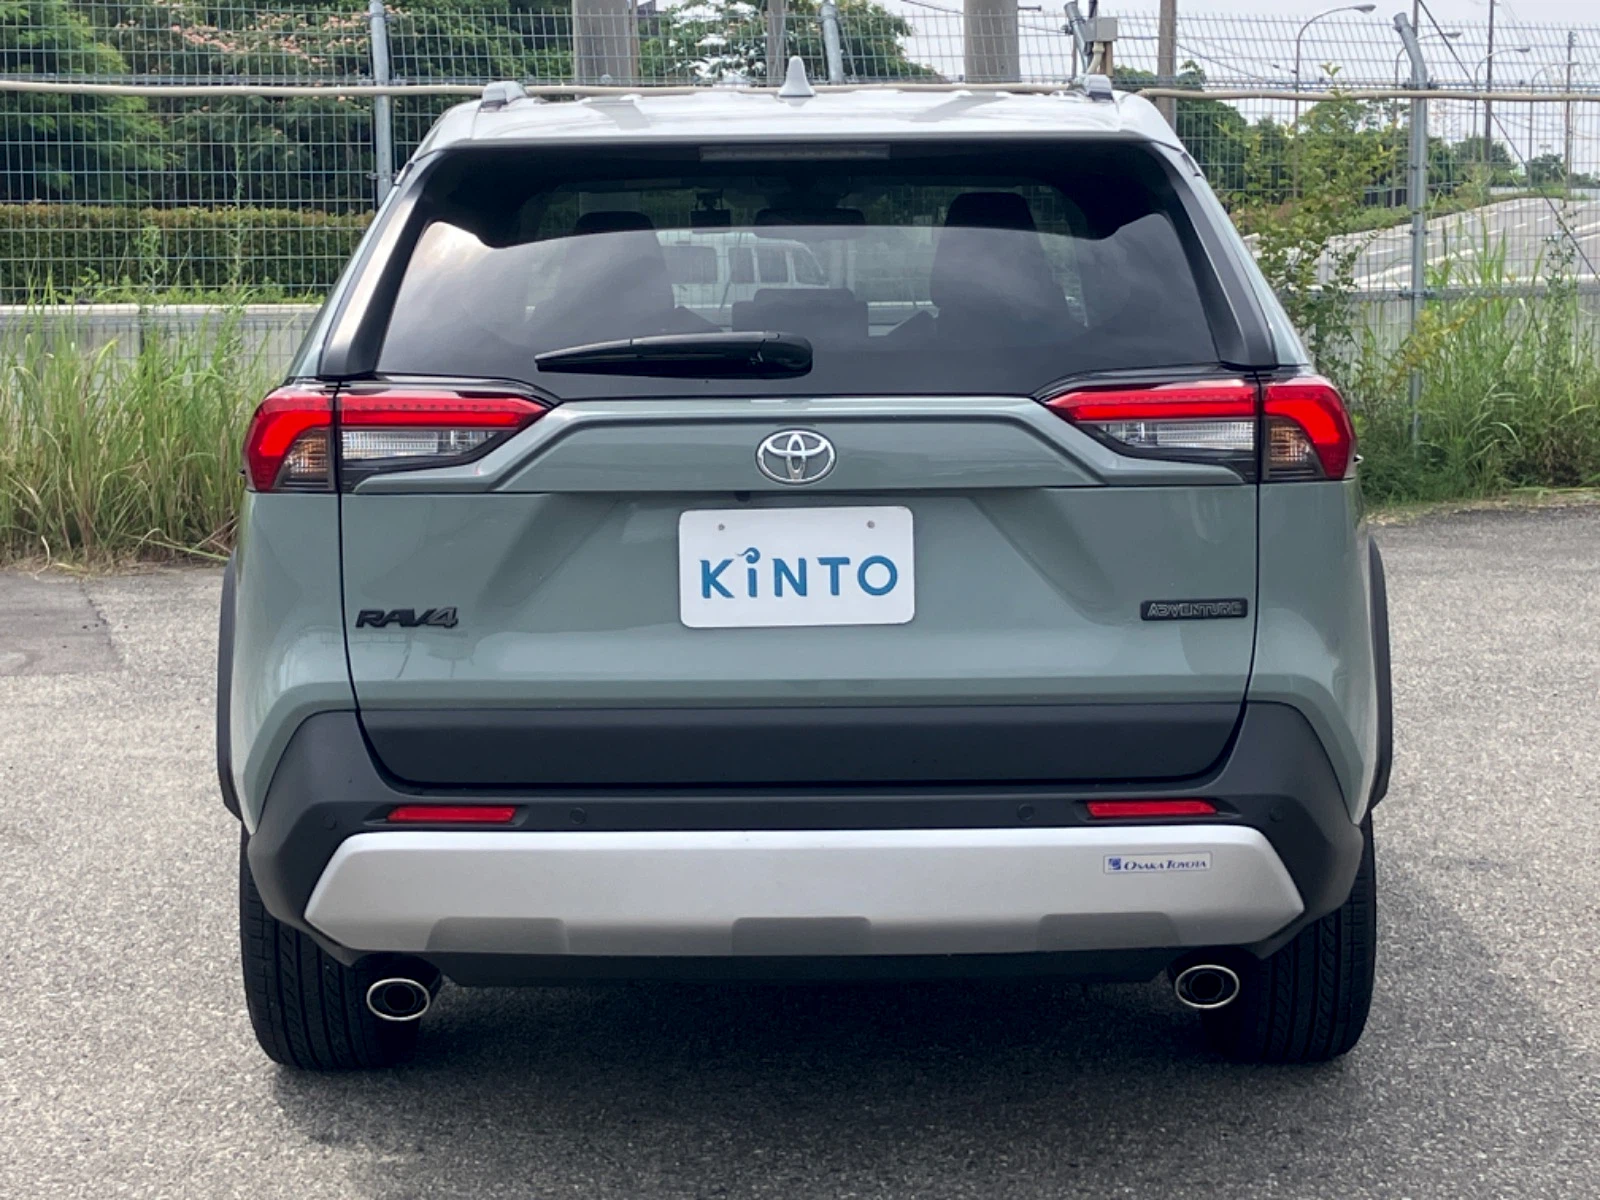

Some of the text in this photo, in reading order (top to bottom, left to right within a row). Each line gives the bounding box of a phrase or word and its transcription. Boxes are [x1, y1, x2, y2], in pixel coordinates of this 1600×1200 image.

[1147, 602, 1243, 617] ADVENTURE
[355, 607, 459, 629] RAV4
[1123, 860, 1207, 871] OSAKA TOYOTA
